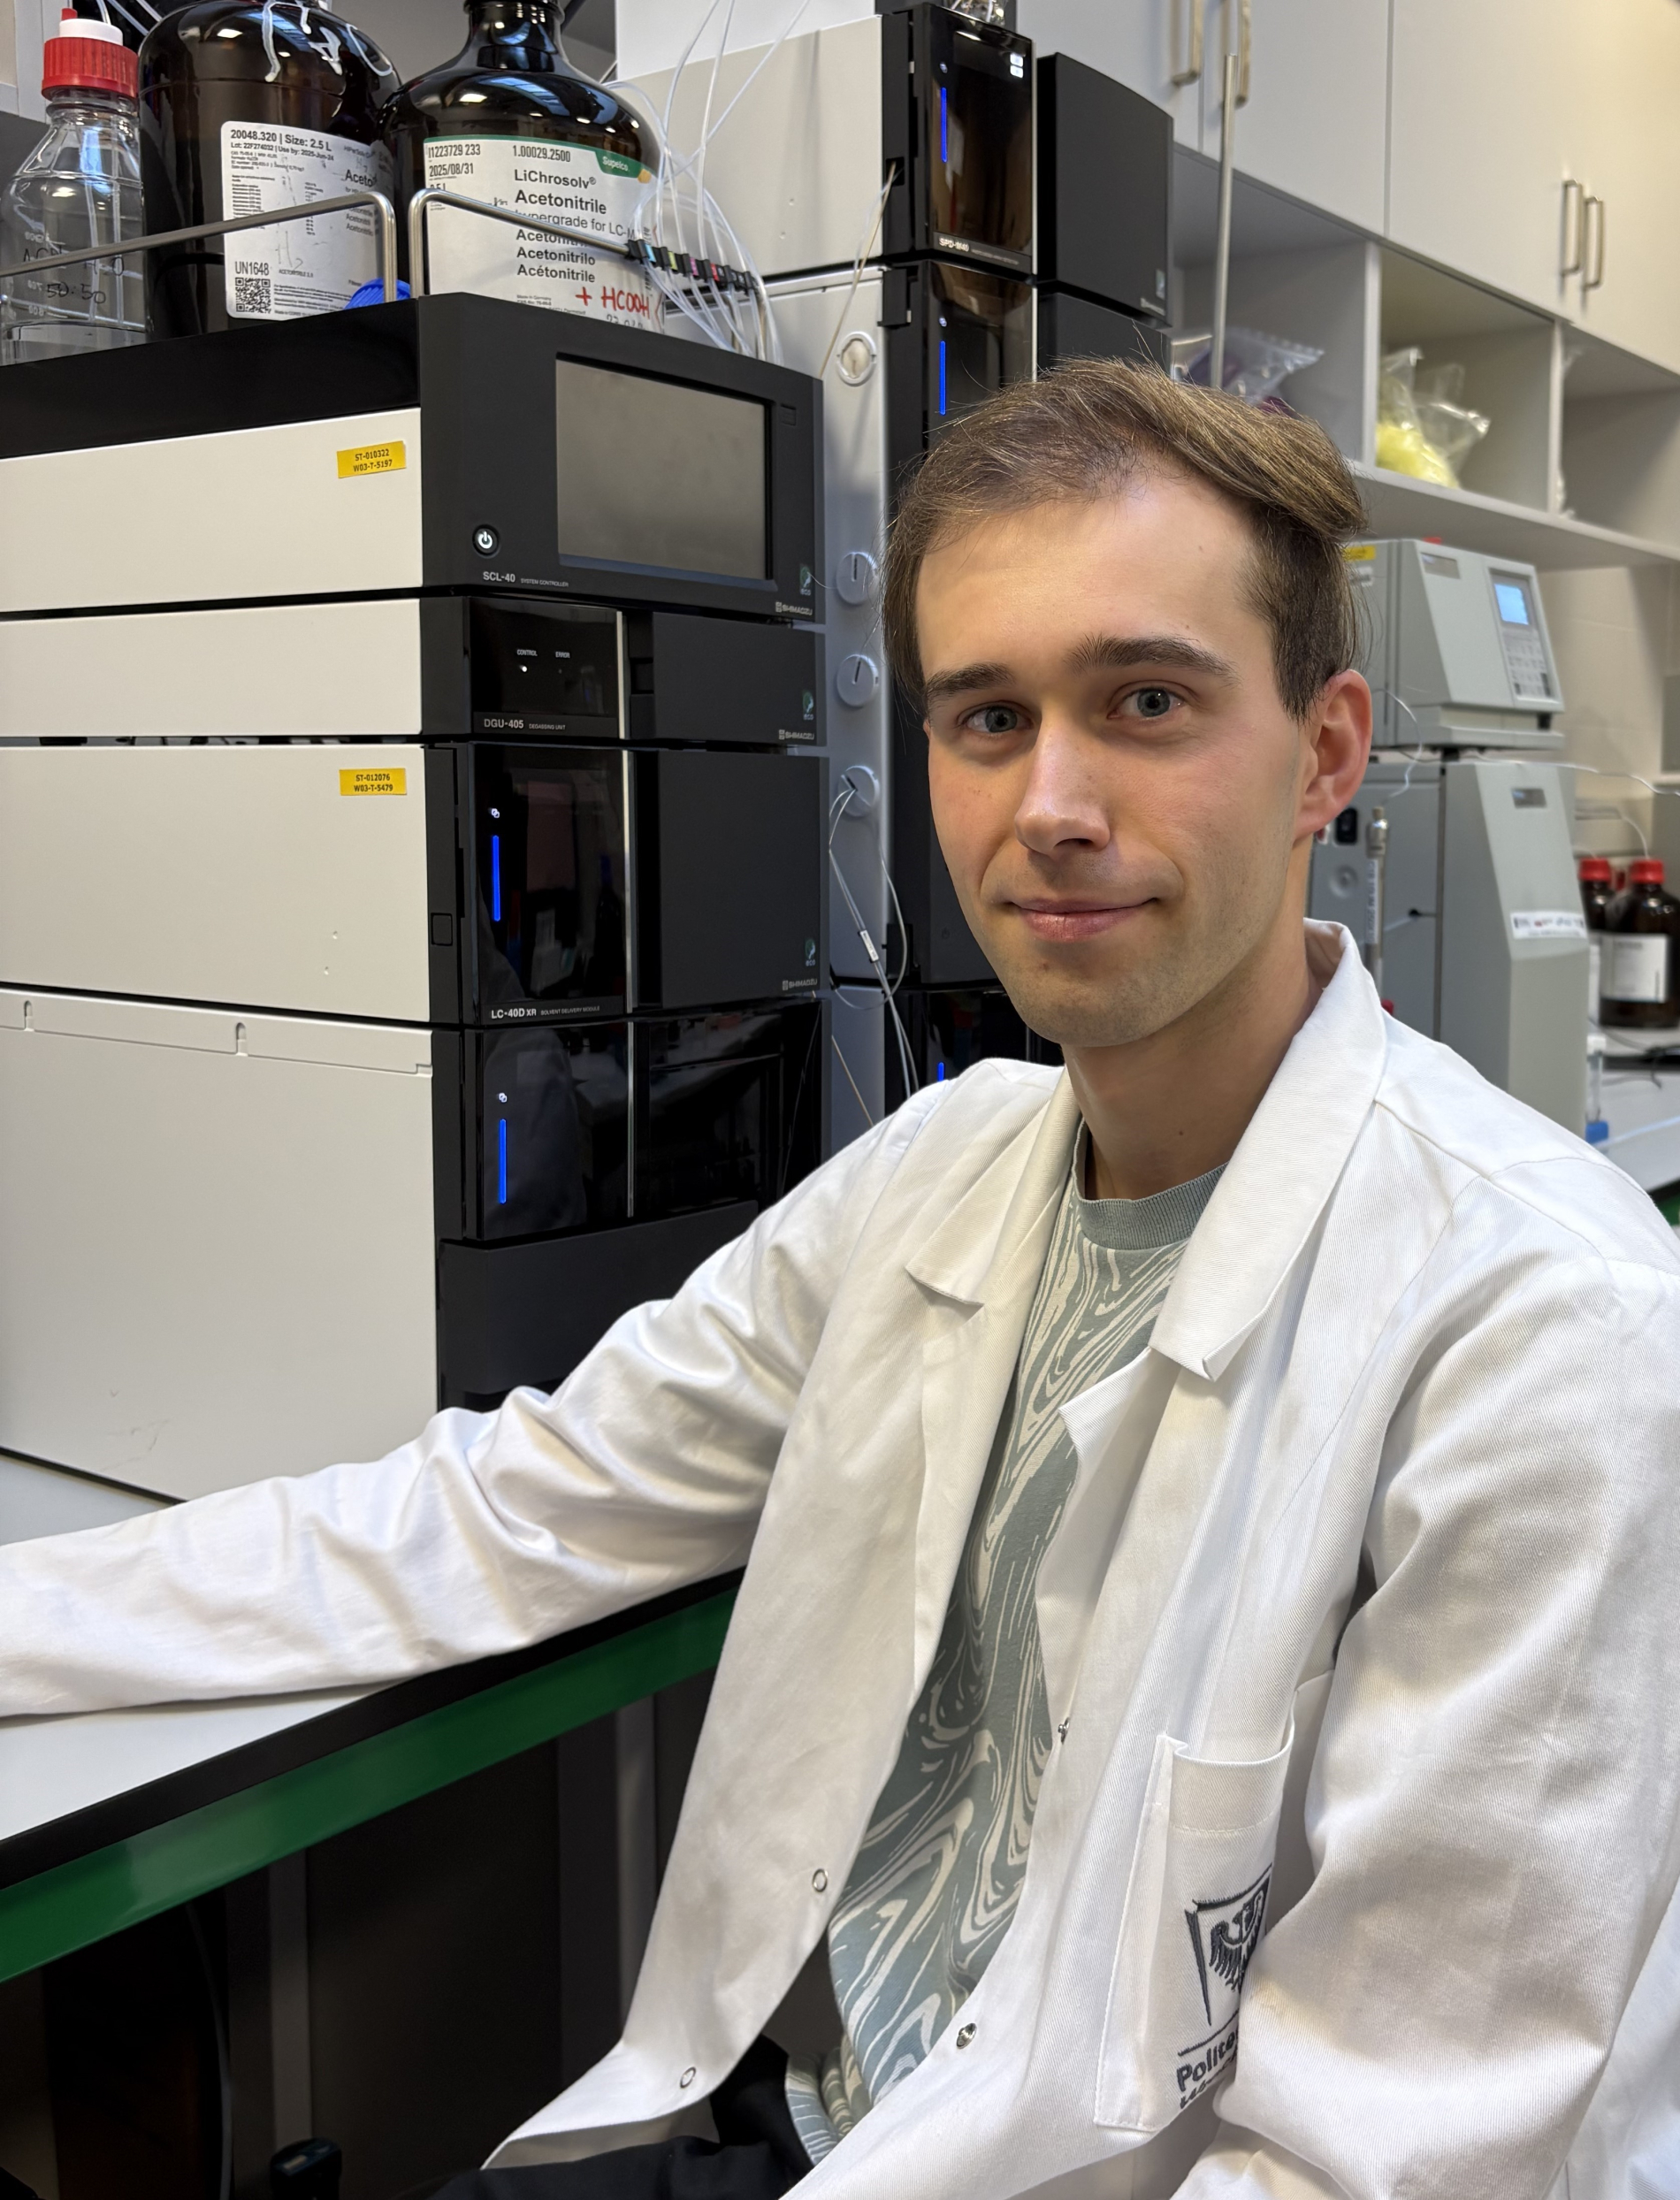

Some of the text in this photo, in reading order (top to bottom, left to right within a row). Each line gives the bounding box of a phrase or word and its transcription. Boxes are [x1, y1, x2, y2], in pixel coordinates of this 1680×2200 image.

[231, 129, 278, 142] 20048.320
[285, 134, 309, 148] Size:
[309, 138, 325, 150] 2.5
[325, 141, 332, 152] L
[464, 143, 481, 157] 233
[512, 145, 571, 163] 1.00029.2500
[429, 163, 475, 177] 2025/08/31
[515, 189, 607, 215] Acetonitrile
[591, 218, 607, 232] for
[516, 247, 596, 266] Acetonitrilo
[234, 261, 270, 277] UN1648
[516, 264, 596, 283] Acétonitrile
[600, 285, 651, 319] HCOOH
[355, 448, 390, 462] ST-010322
[353, 459, 393, 473] W03-T-5197
[483, 570, 515, 584] SCL-40
[484, 718, 524, 730] DGU-405
[355, 773, 391, 783] ST-012076
[354, 783, 393, 793] W03-T-5479
[525, 1008, 537, 1018] XR
[1176, 2020, 1239, 2093] Polite
